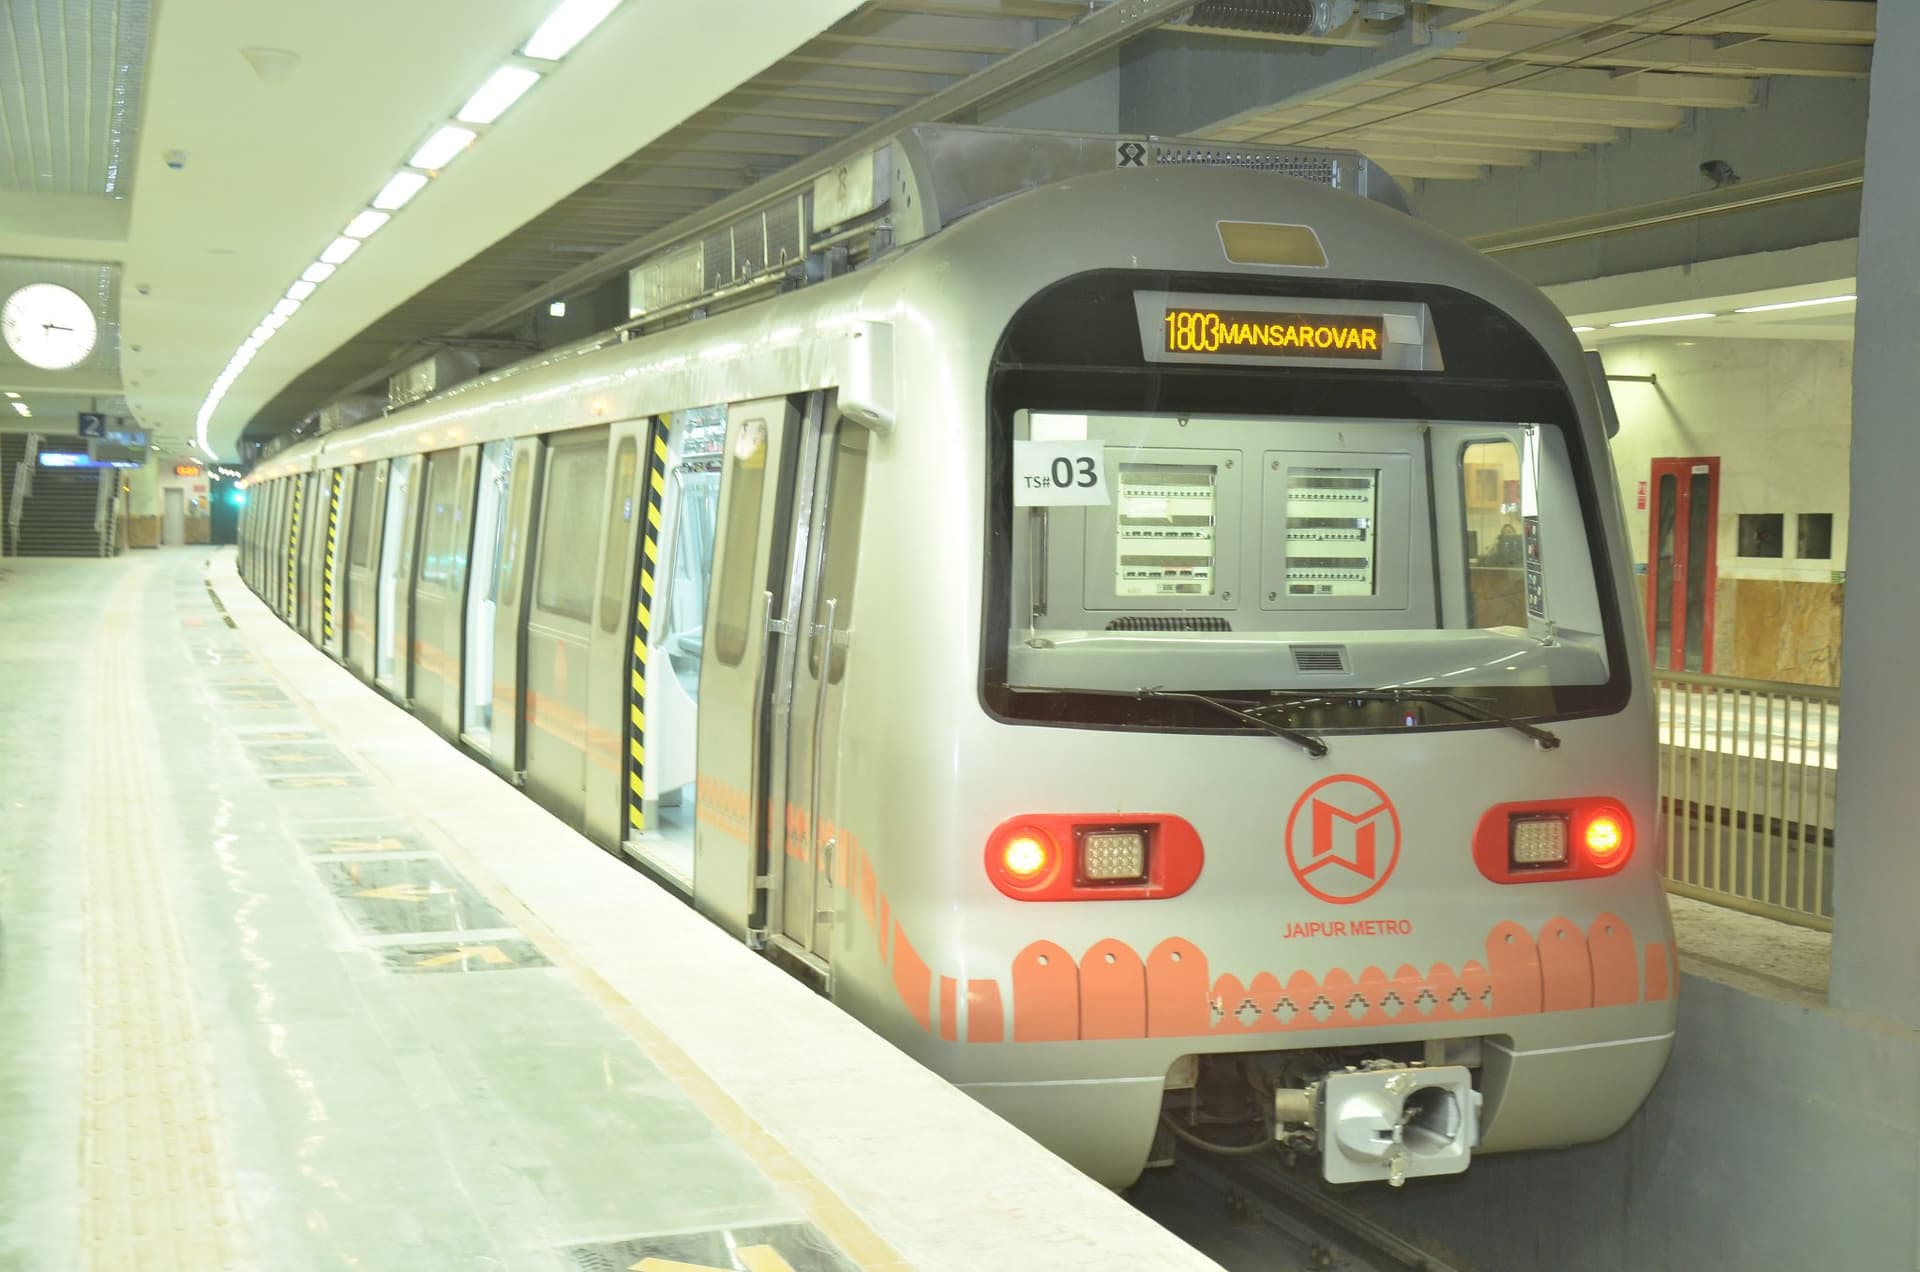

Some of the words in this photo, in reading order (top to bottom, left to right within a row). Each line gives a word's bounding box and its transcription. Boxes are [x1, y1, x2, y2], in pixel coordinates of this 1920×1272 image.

[1165, 311, 1220, 352] 1803
[1219, 322, 1377, 350] MANSAROVAR
[82, 415, 101, 436] 2
[1283, 920, 1347, 939] JAIPUR
[1350, 919, 1412, 936] METRO
